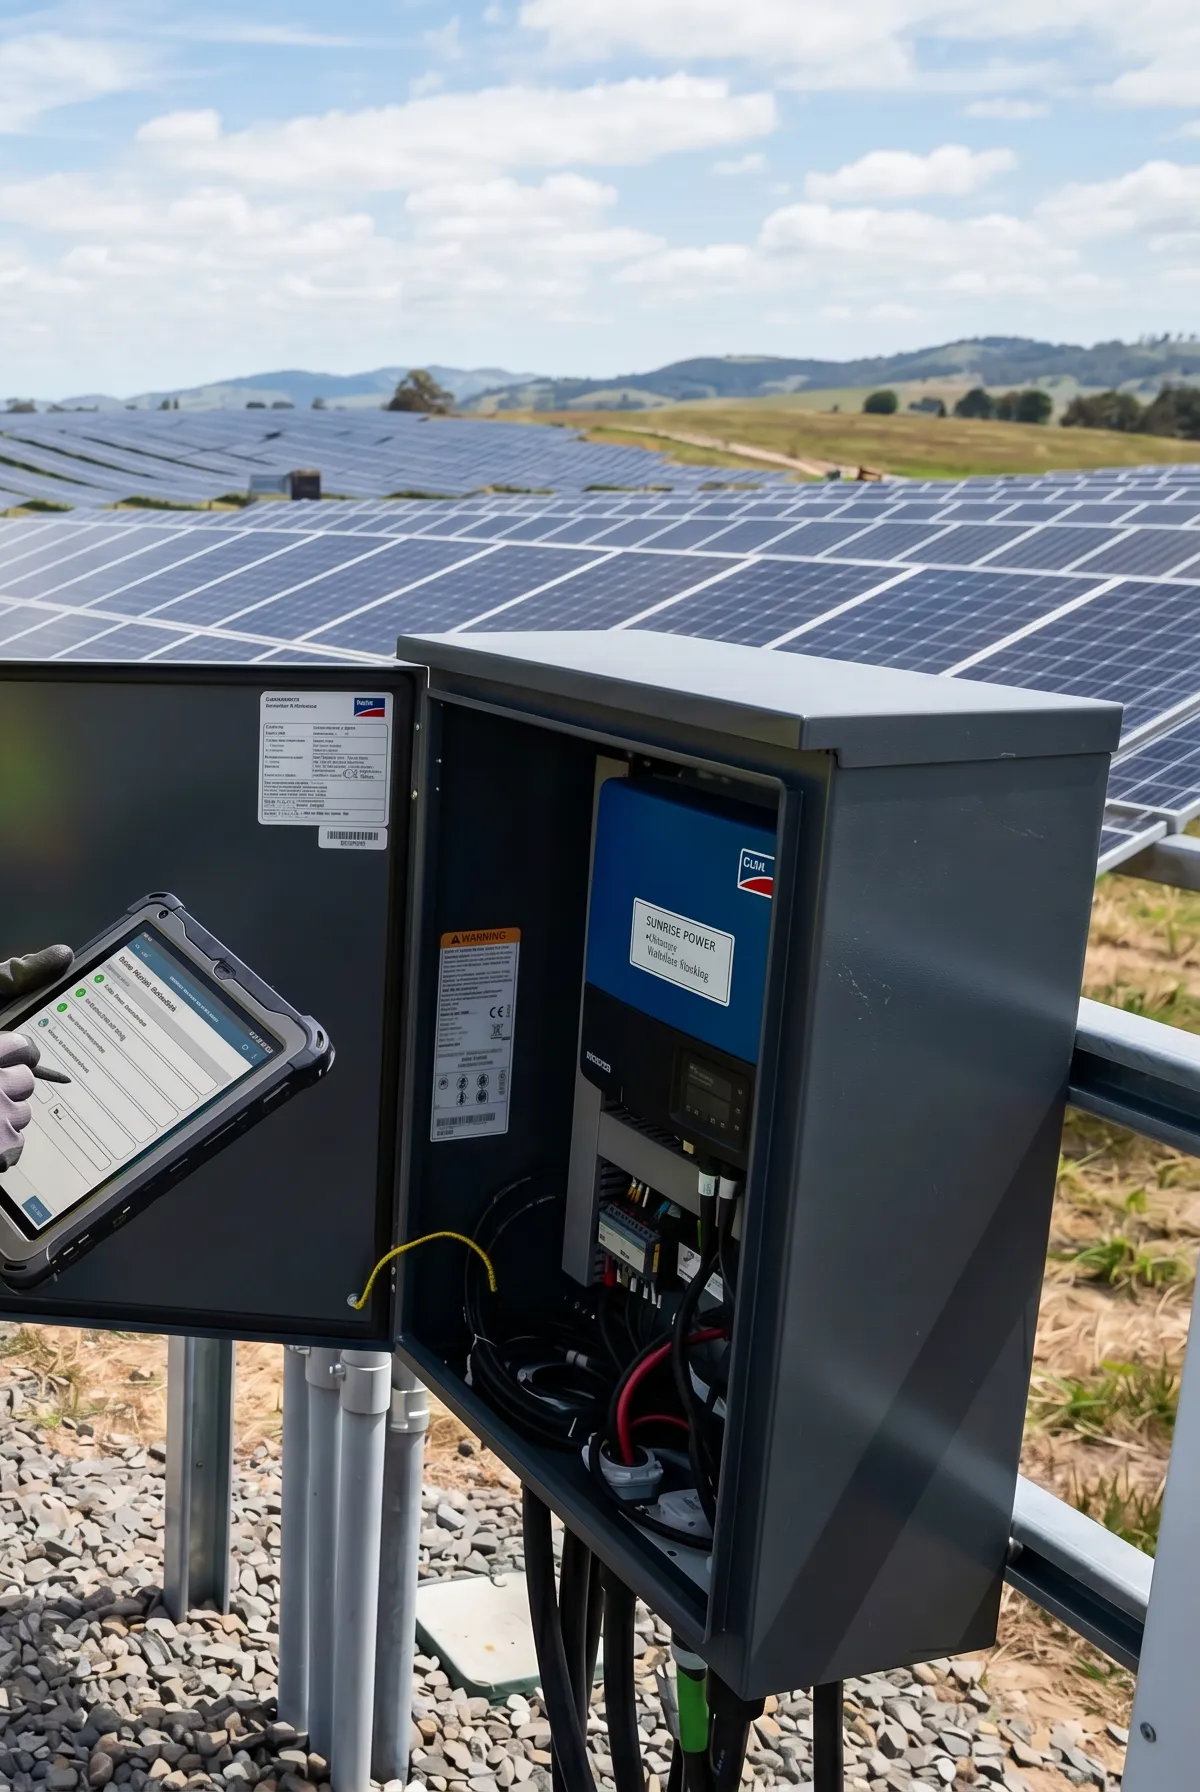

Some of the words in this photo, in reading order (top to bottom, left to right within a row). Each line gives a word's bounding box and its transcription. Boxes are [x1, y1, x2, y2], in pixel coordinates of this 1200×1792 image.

[461, 931, 506, 943] WARNING
[646, 915, 681, 938] SUNRISE
[683, 930, 716, 952] POWER
